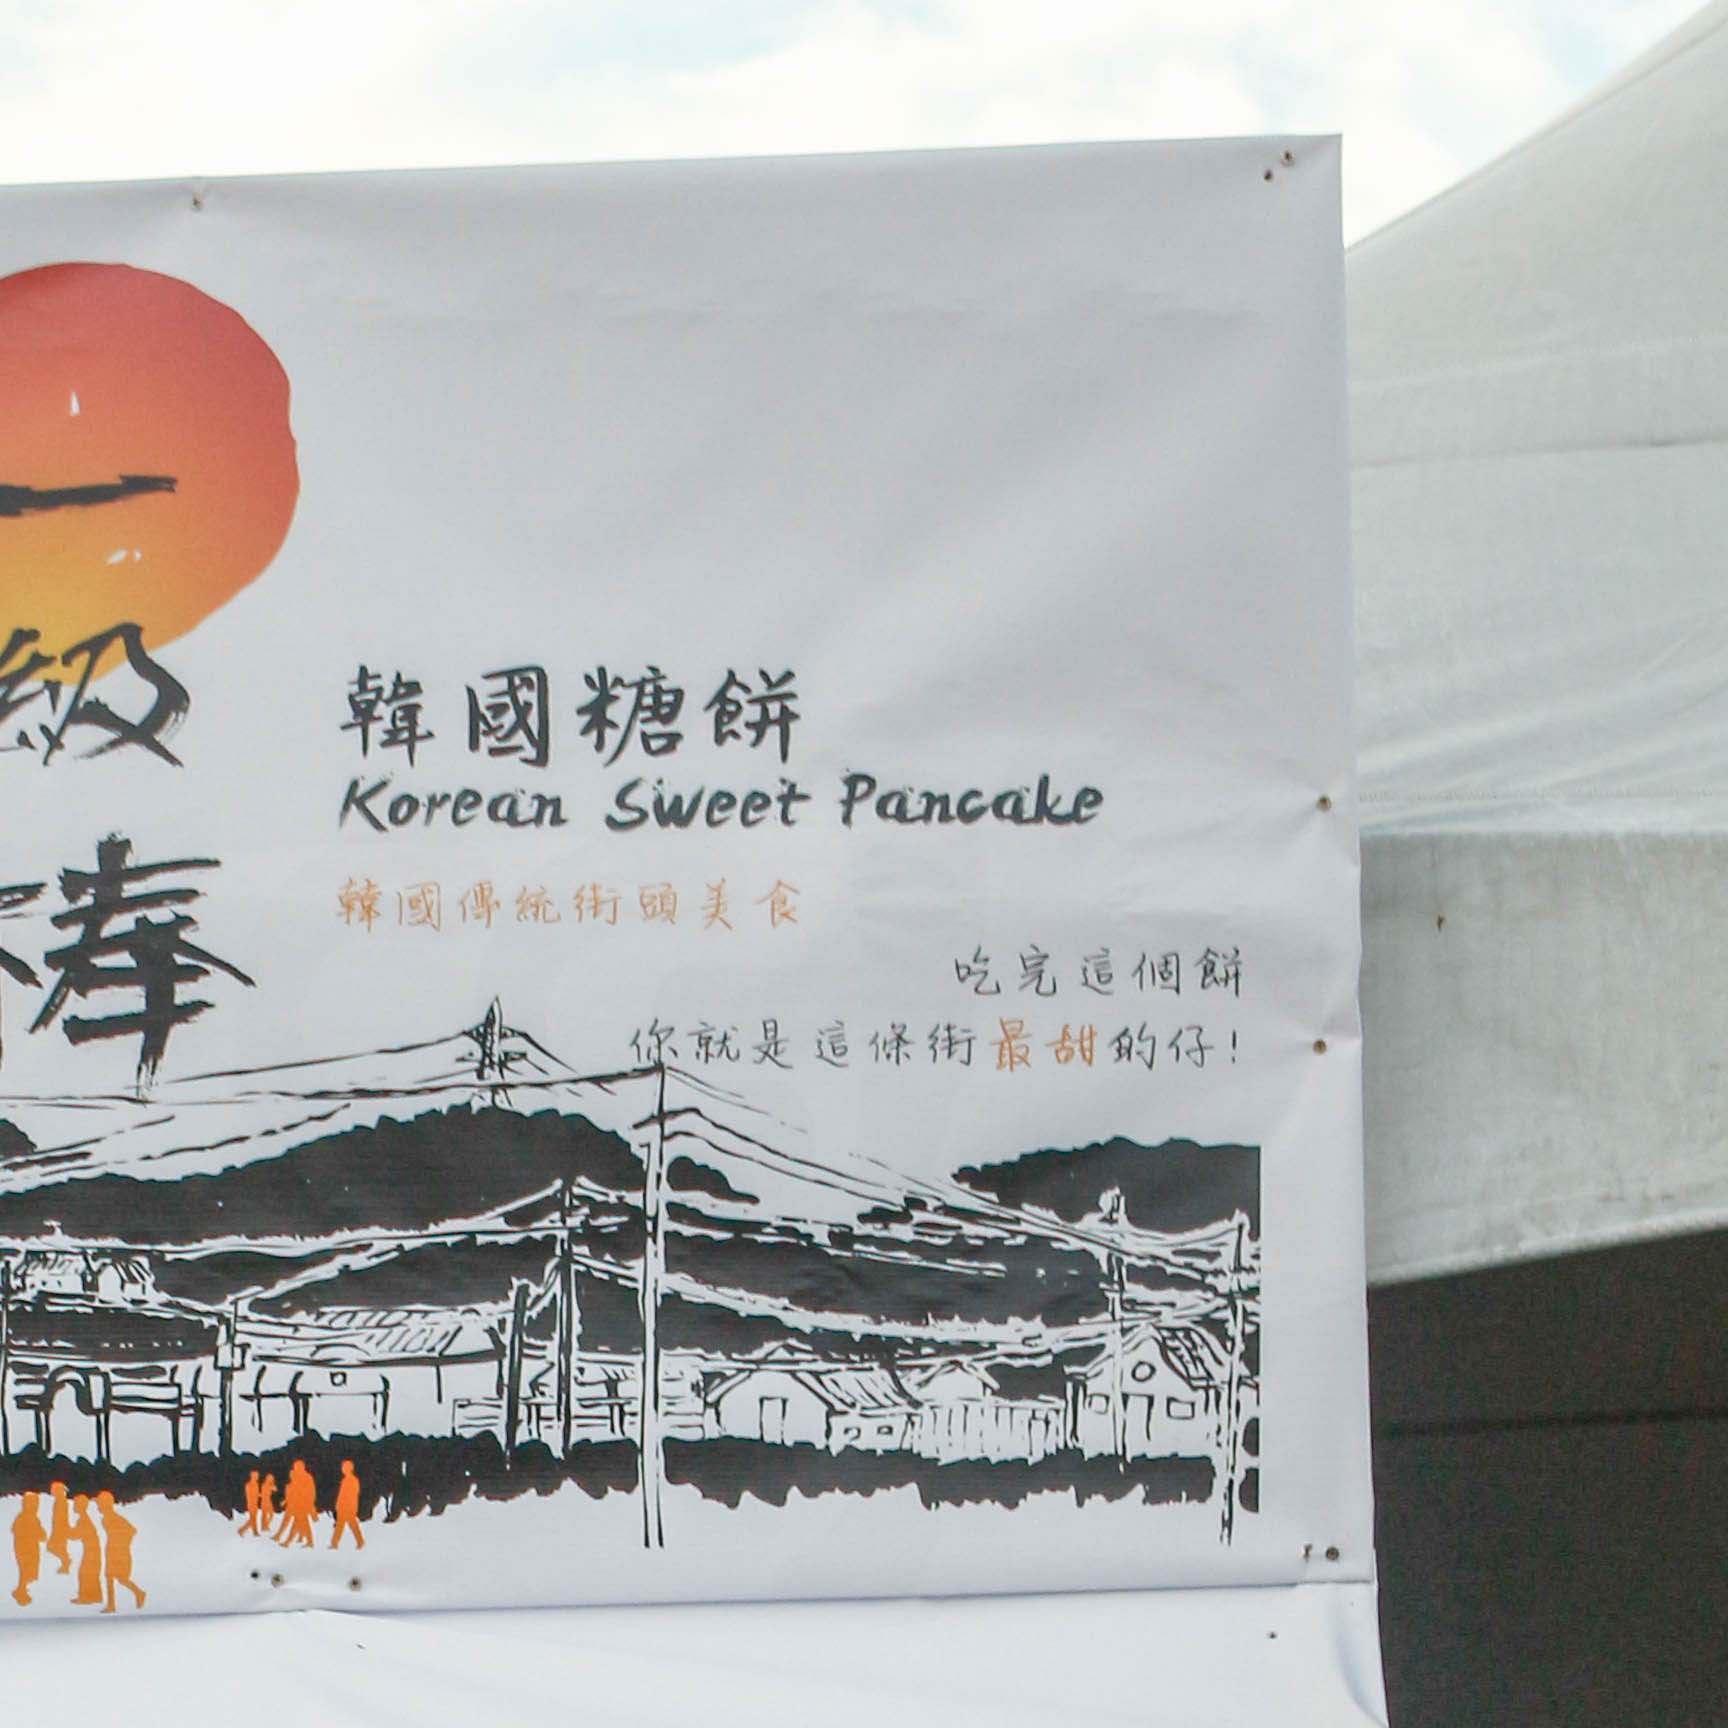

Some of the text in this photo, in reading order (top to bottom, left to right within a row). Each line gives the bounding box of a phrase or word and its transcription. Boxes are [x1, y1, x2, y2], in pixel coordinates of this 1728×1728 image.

[340, 664, 801, 768] 韓國糖餅
[339, 768, 1105, 833] Korean Sweet Pancake
[337, 876, 800, 932] 韓國傳統街頭美食
[955, 944, 1243, 999] 吃完這個餅
